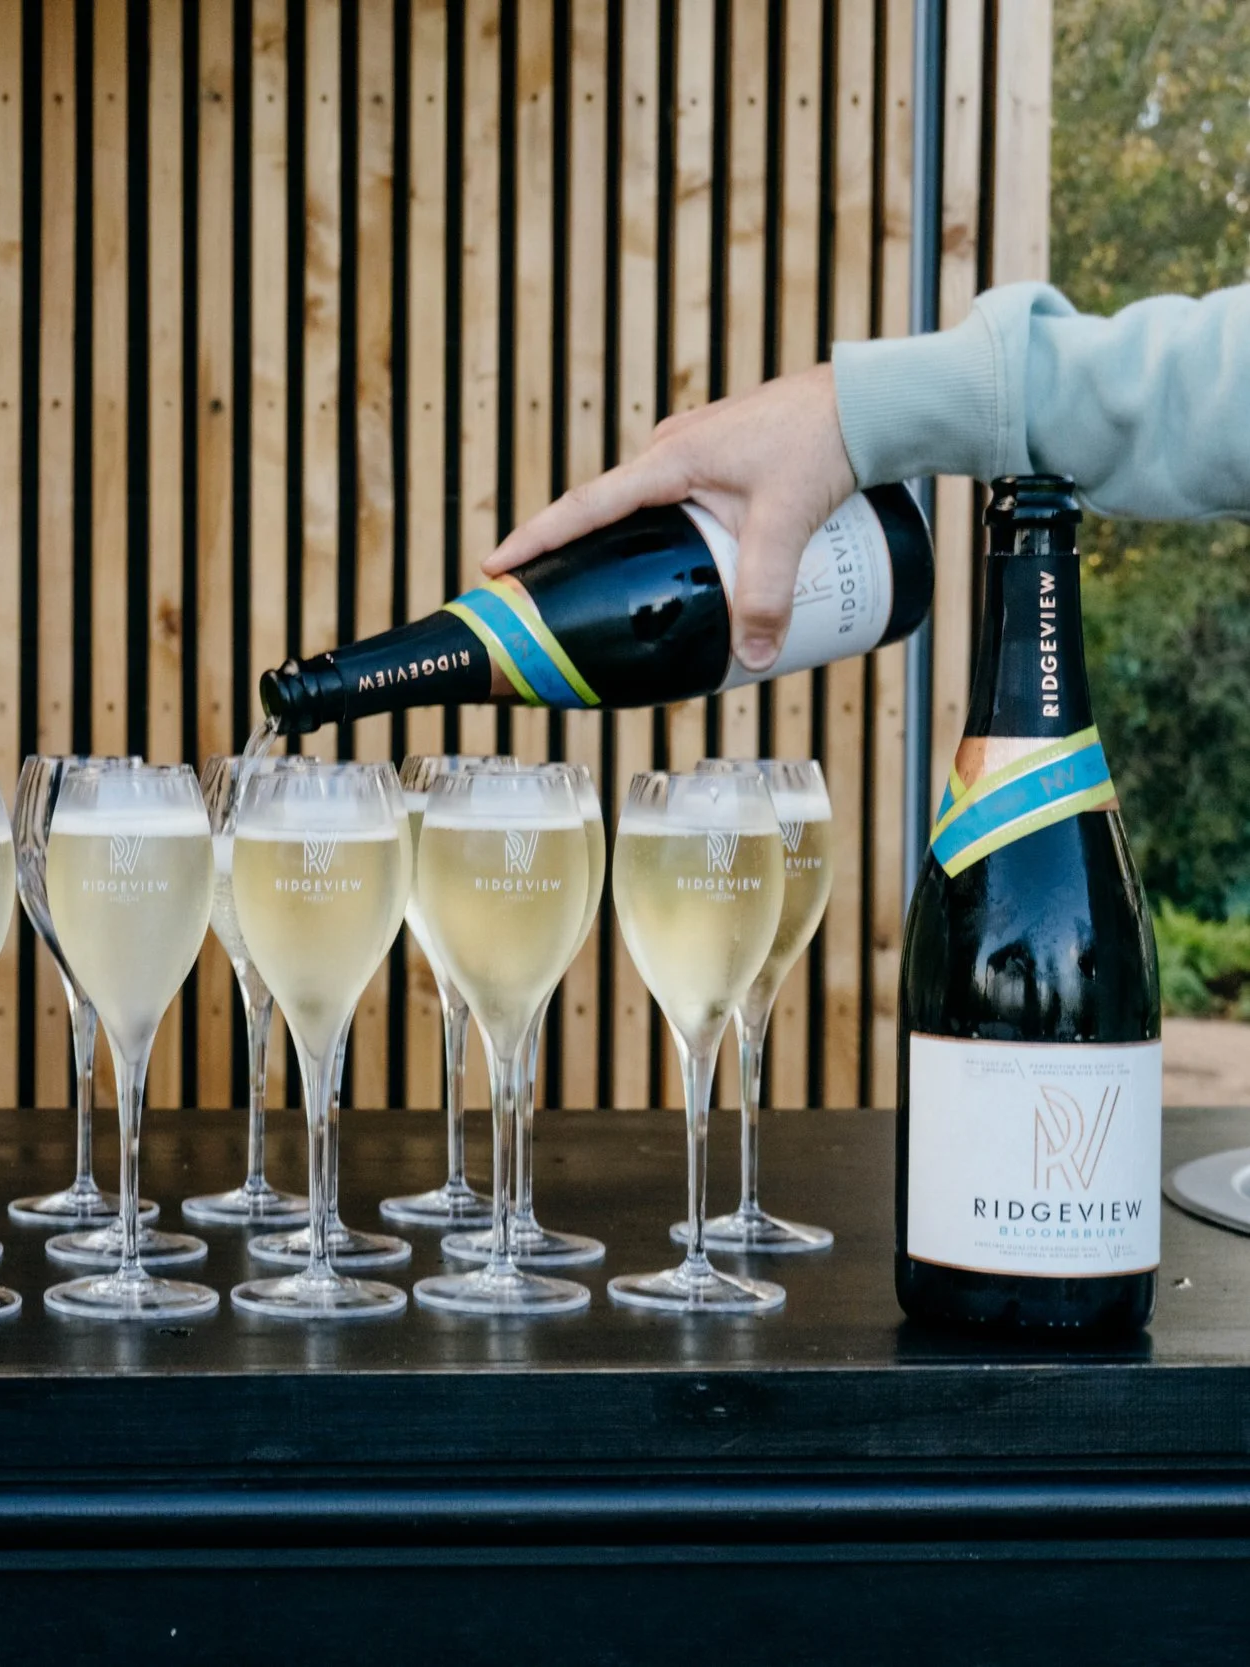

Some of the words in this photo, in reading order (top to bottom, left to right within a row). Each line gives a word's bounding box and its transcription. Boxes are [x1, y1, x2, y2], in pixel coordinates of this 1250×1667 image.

[824, 520, 857, 634] RIDGEVIE
[1039, 570, 1060, 717] RIDGEVIEW
[358, 649, 470, 693] RIDGEVIEW
[785, 856, 822, 869] EVIEW
[82, 880, 168, 893] RIDGEVIEW
[275, 878, 361, 892] RIDGEVIEW
[475, 877, 561, 892] RIDGEVIEW
[677, 877, 761, 891] RIDGEVIEW
[973, 1197, 1142, 1223] RIDGEVIEW
[999, 1225, 1125, 1239] BLOOMSBURY
